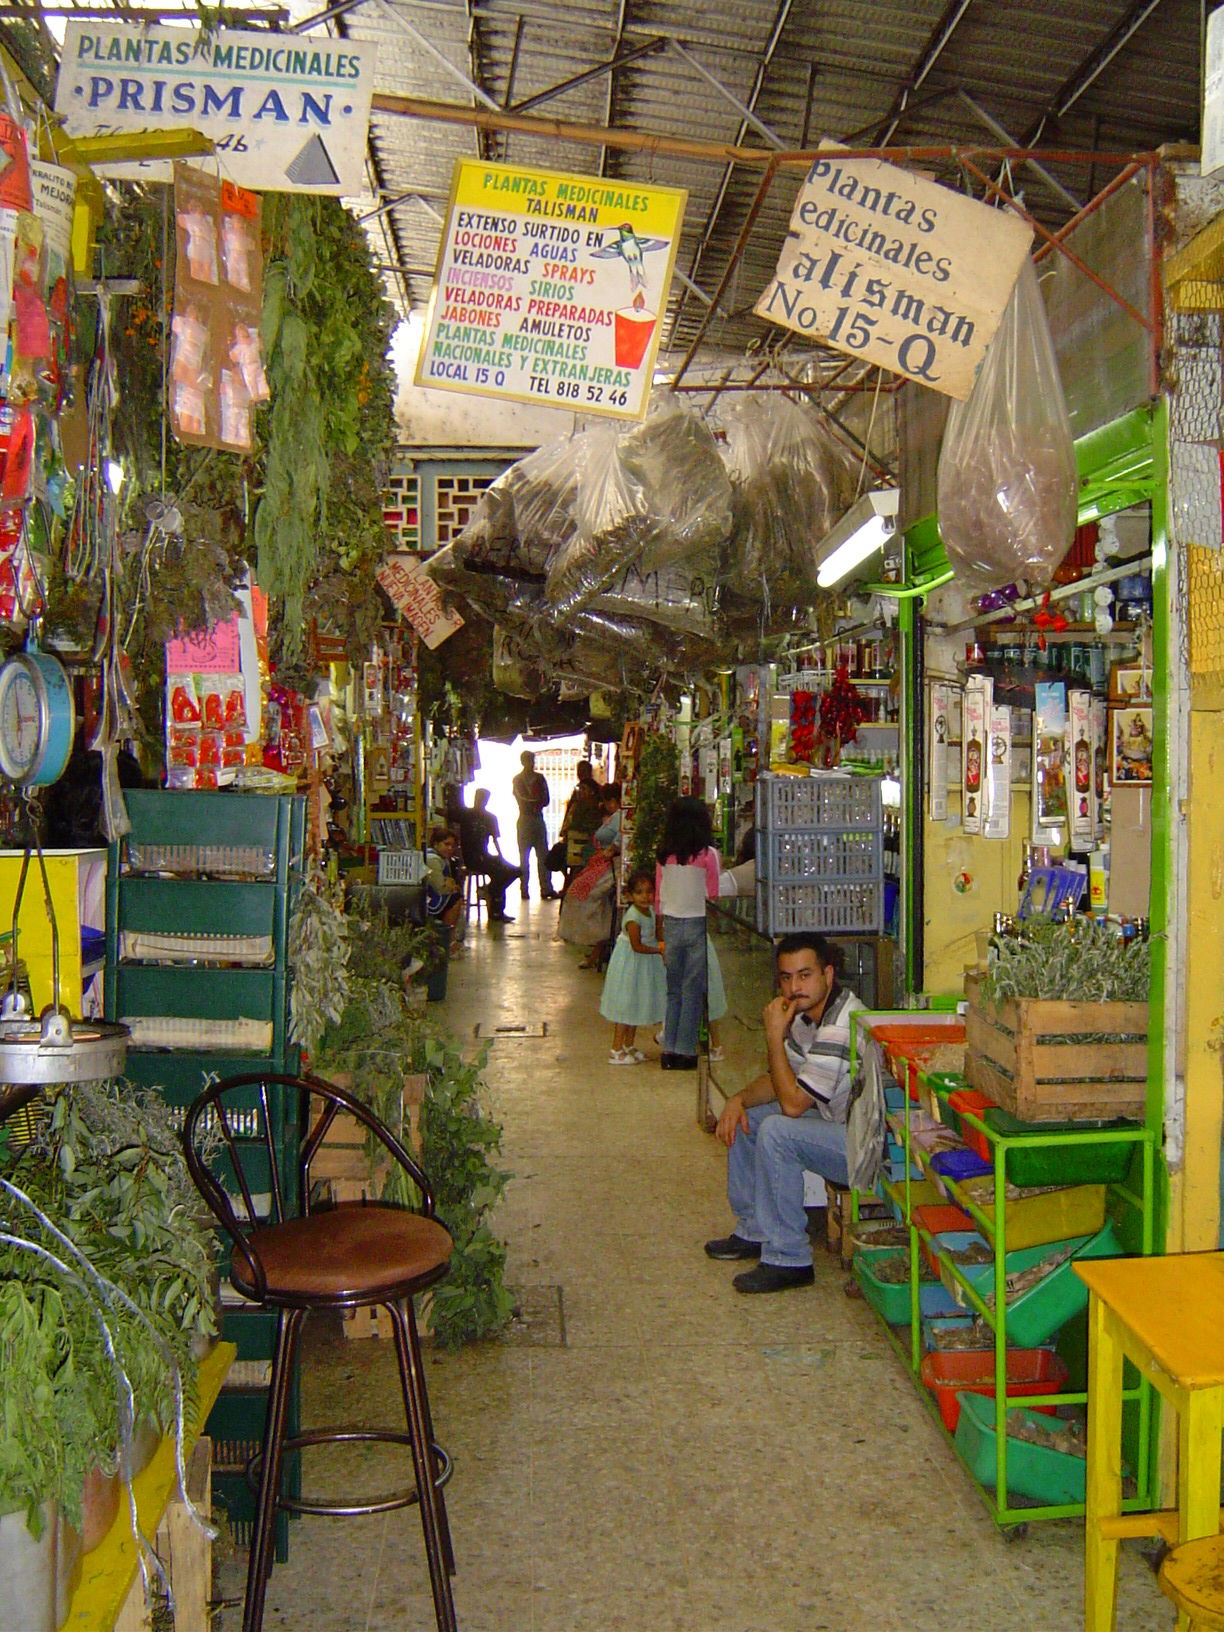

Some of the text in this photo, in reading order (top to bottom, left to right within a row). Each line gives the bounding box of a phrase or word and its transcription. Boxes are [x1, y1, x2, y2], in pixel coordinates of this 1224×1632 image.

[78, 35, 361, 79] PLANTAS MEDICINALES
[88, 77, 334, 126] PRISMAN
[483, 172, 649, 212] PLANTAS MEDICINALES
[526, 198, 599, 223] TALISMAN
[807, 159, 938, 233] Plantas
[454, 231, 578, 263] LOCIONES AGUAS
[457, 212, 604, 248] EXTENSO SURTIDO EN
[447, 267, 575, 301] INCIENSOS SIRIOS
[453, 248, 596, 285] VELADORAS SPRAYS
[441, 304, 592, 342] JABONES AMULETOS
[445, 286, 614, 327] VELADORAS PREPARADAS
[436, 323, 588, 361] PLANTAS MEDICINALES
[430, 361, 628, 407] LOCAL 15 Q TEL 818 52 46
[433, 341, 632, 388] NACIONALES Y EXTRANJERAS
[389, 561, 440, 625] MEDICINALES
